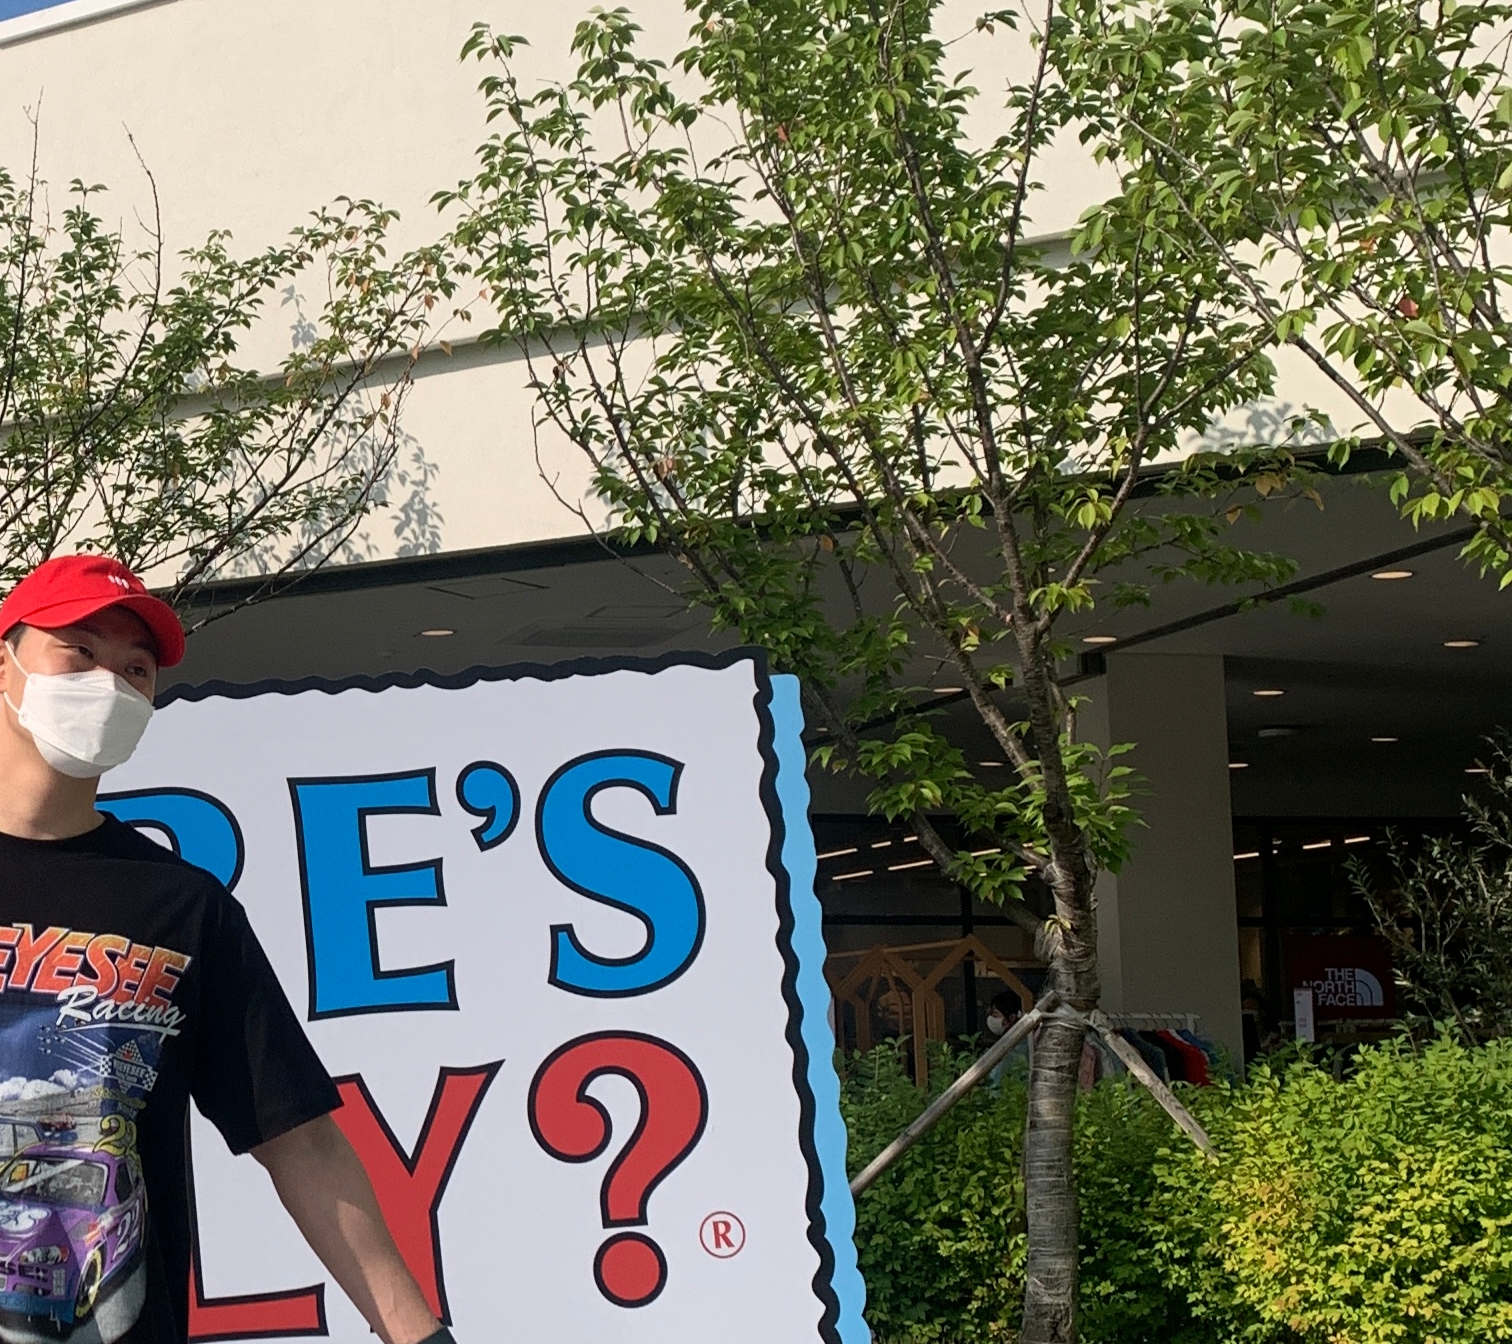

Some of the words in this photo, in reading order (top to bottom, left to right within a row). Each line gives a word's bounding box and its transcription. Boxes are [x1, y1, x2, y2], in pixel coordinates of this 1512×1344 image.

[1325, 968, 1355, 981] THE
[1318, 993, 1355, 1006] FACE
[56, 985, 187, 1044] Racing
